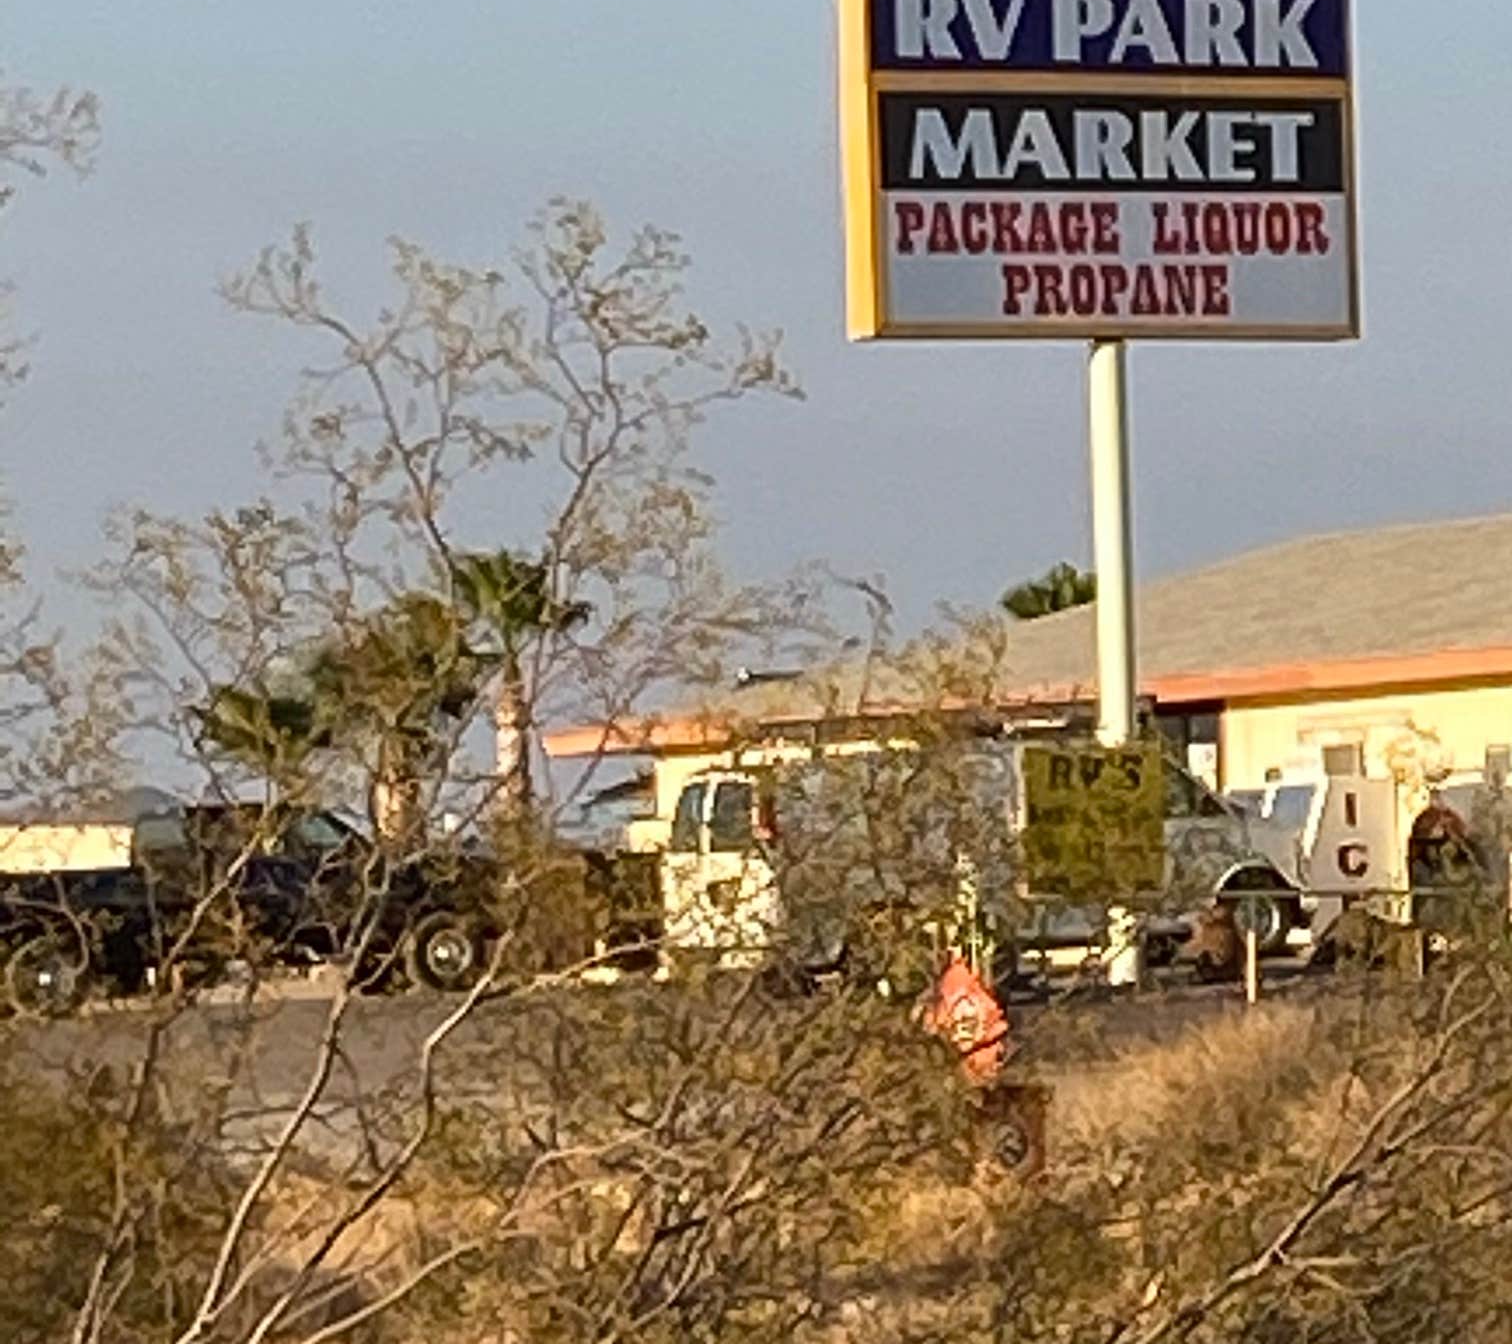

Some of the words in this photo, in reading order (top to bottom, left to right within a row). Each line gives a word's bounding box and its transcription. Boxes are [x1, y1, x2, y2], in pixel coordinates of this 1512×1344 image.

[908, 107, 1316, 182] MARKET
[894, 201, 1121, 255] PACKAGE
[1151, 201, 1331, 256] LIQUOR
[1001, 264, 1231, 317] PROPANE
